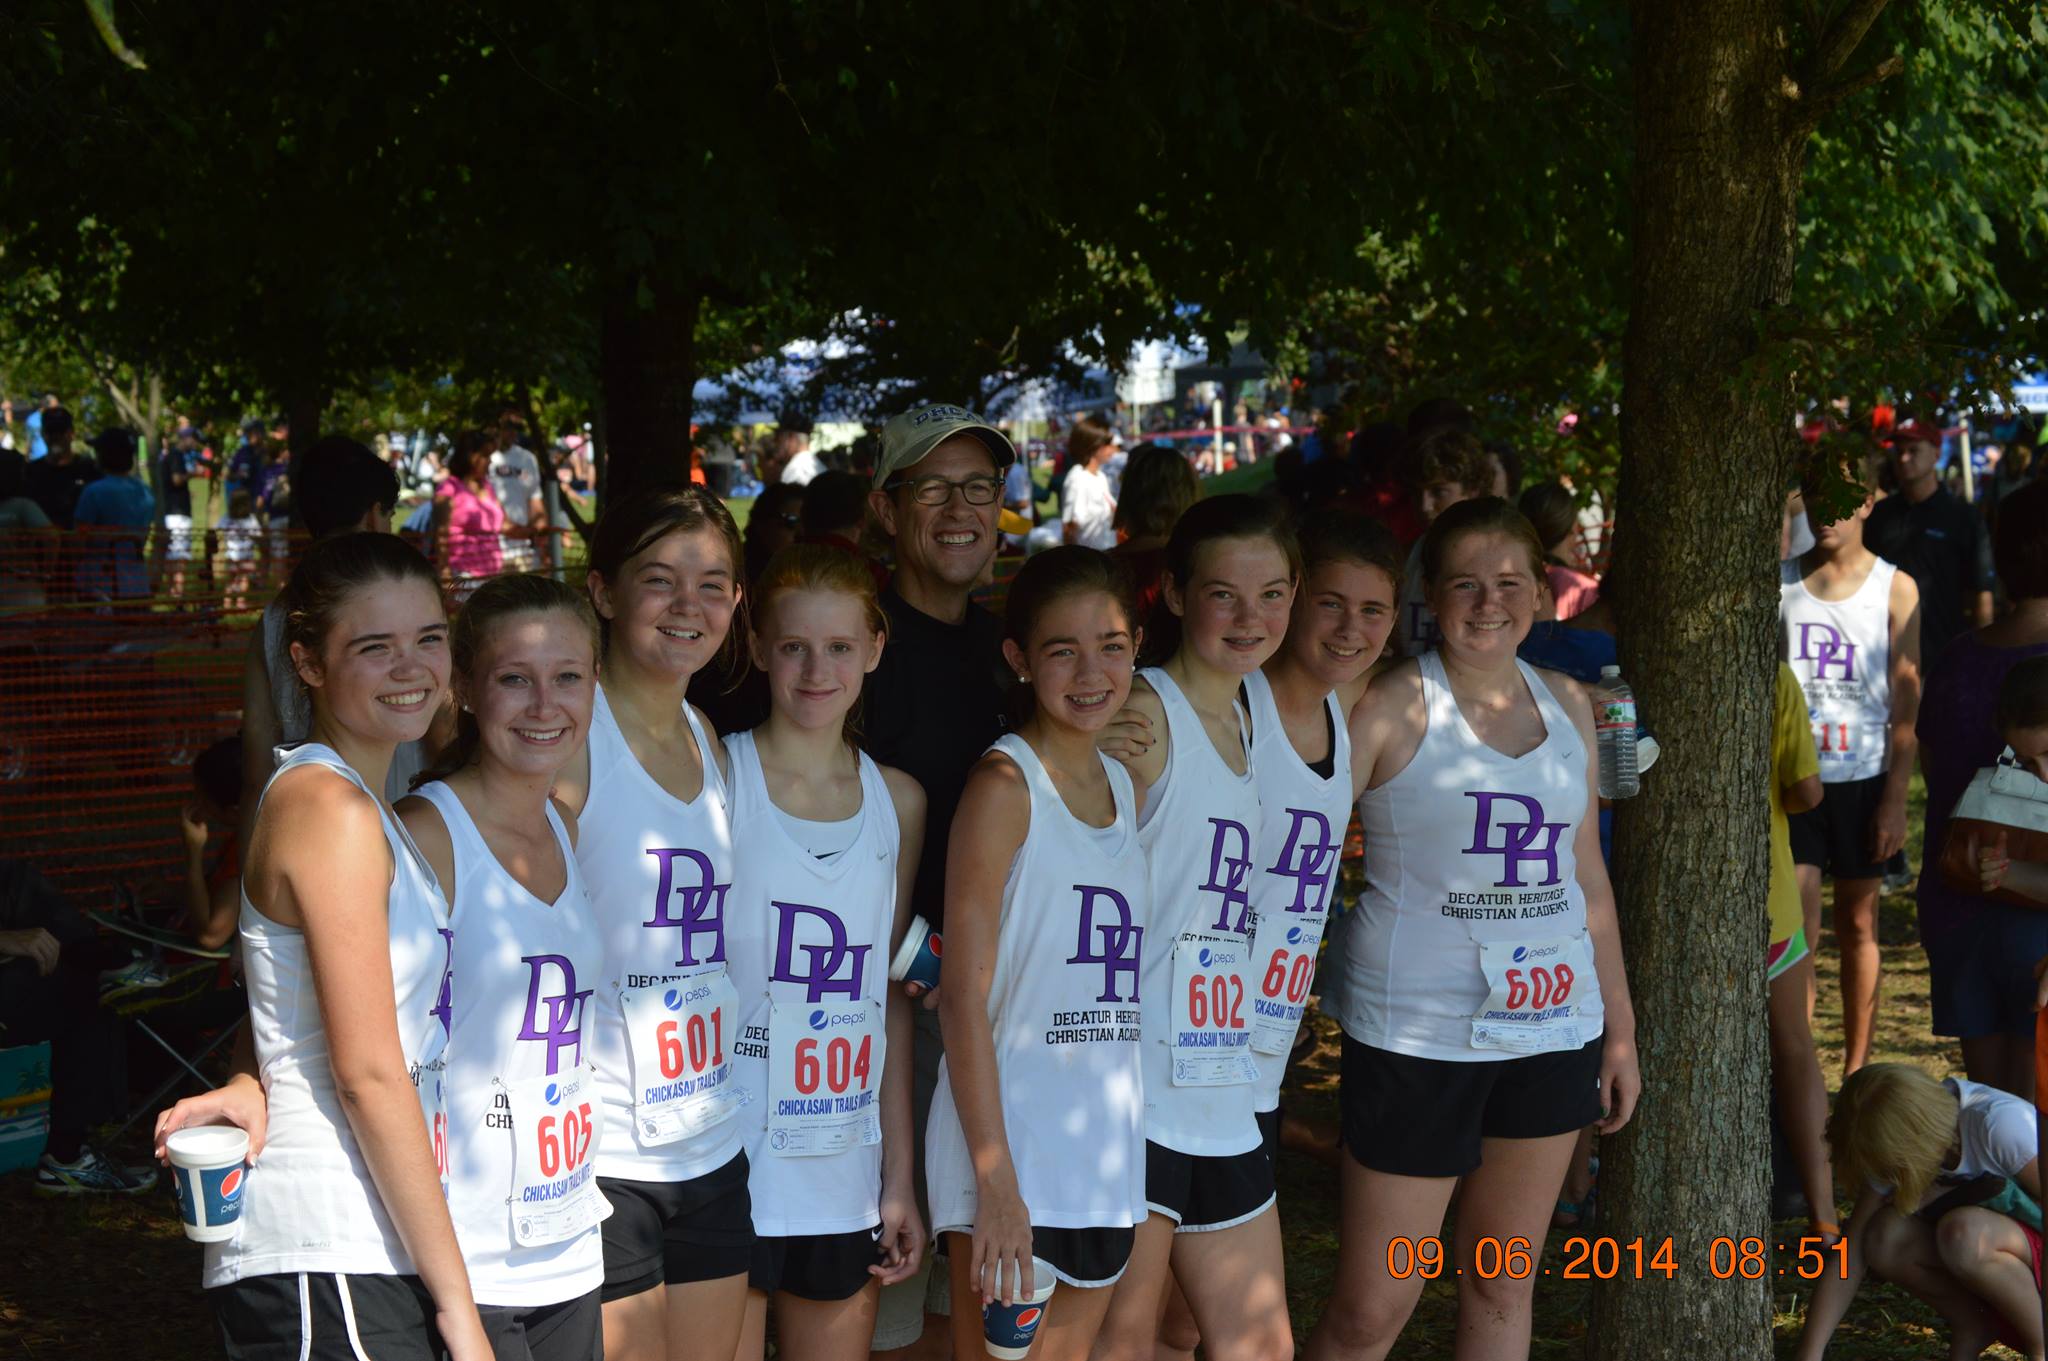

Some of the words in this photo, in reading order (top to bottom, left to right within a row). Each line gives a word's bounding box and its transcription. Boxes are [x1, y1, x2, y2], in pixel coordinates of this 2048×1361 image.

[1794, 622, 1860, 683] DH
[1808, 721, 1850, 752] 11
[1461, 791, 1571, 888] DH
[1198, 817, 1253, 935] DH
[1266, 807, 1341, 913] DH
[642, 848, 732, 968] DH
[1441, 905, 1517, 920] CHRISTIAN
[1520, 900, 1570, 919] ACADEMY
[1448, 891, 1513, 905] DECATUR
[1518, 888, 1566, 904] HERITAGE
[768, 900, 873, 1003] DH
[1066, 884, 1143, 1004] DH
[1213, 953, 1237, 965] pepsi
[1528, 944, 1560, 961] pepsi
[685, 984, 711, 1005] pepsi
[1189, 973, 1245, 1028] 602
[1505, 963, 1575, 1010] 608
[516, 954, 594, 1077] DH
[831, 1010, 866, 1027] pepsi
[1053, 1010, 1111, 1026] DECATUR
[1484, 1010, 1530, 1022] CHICKASAW
[1551, 1005, 1572, 1018] INVITE
[656, 1006, 723, 1080] 601
[1046, 1028, 1114, 1045] CHRISTIAN
[1178, 1032, 1218, 1048] CHICKASAW
[1219, 1032, 1236, 1047] TRAILS
[795, 1034, 872, 1095] 604
[562, 1080, 580, 1101] pepsi
[645, 1079, 696, 1105] CHICKASAW
[697, 1070, 716, 1093] TRAILS
[778, 1098, 833, 1117] CHICKASAW
[835, 1096, 858, 1114] TRAILS
[537, 1102, 593, 1178] 605
[523, 1178, 568, 1202] CHICKASAW
